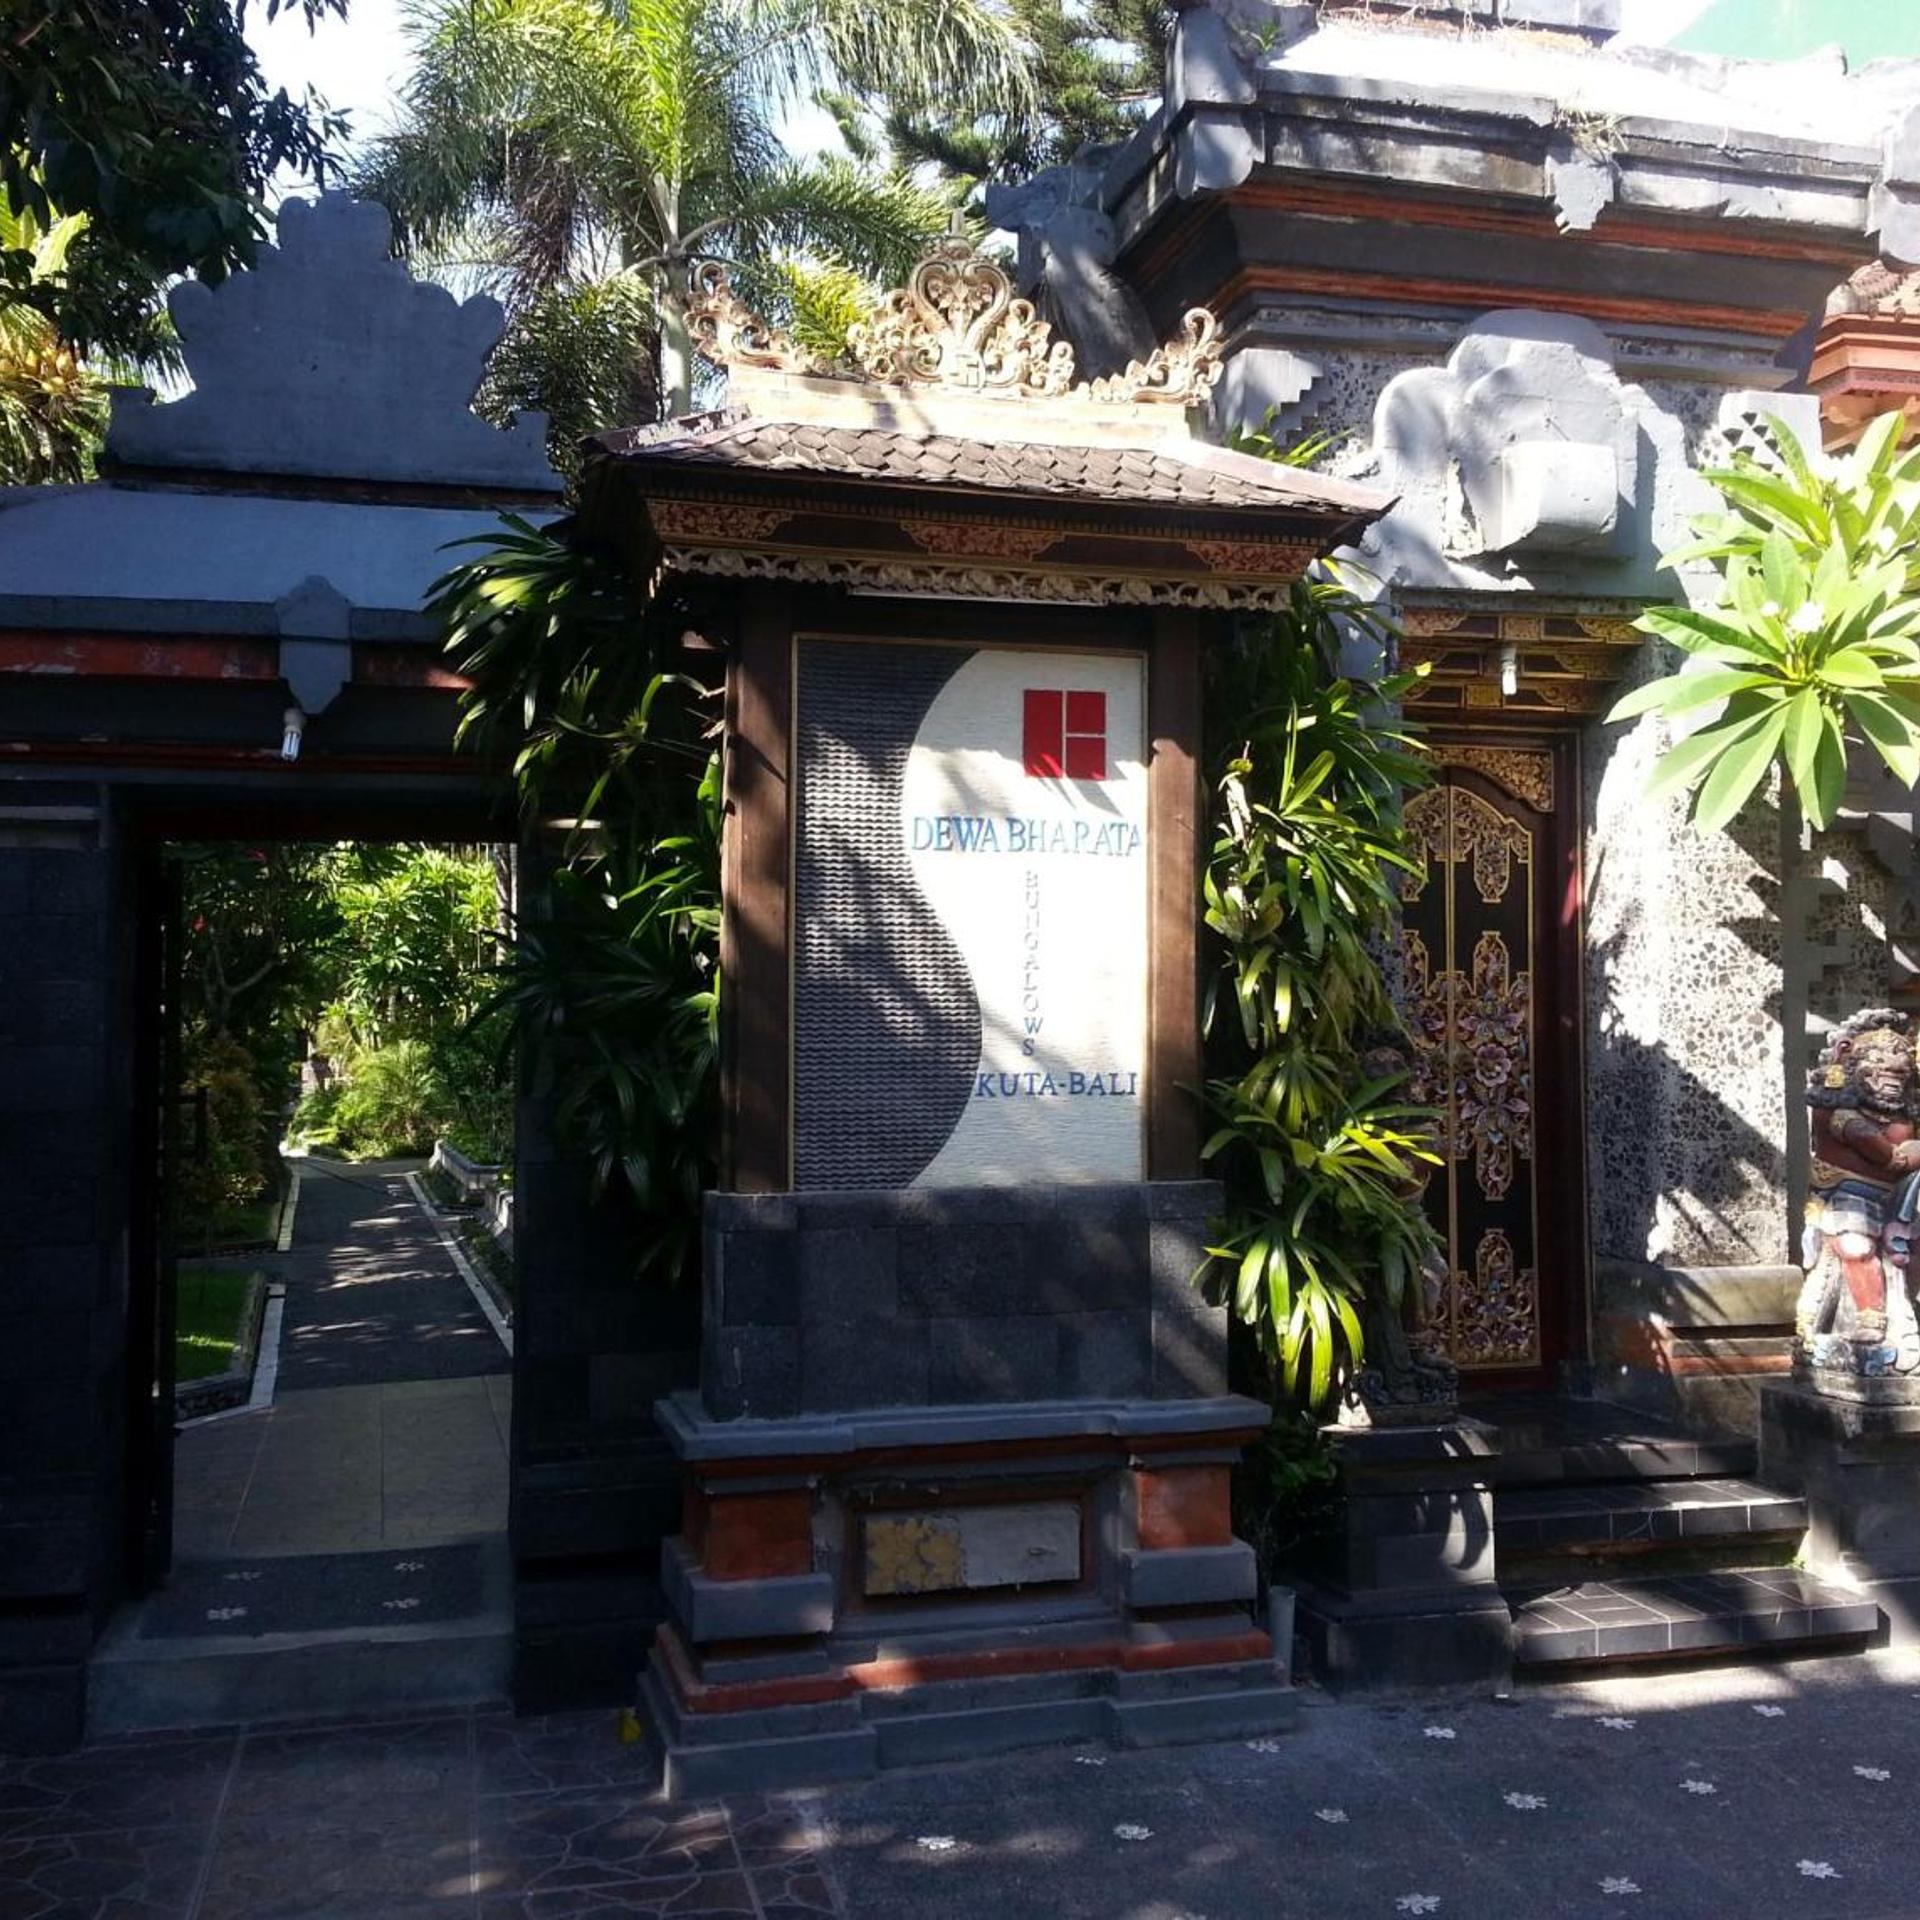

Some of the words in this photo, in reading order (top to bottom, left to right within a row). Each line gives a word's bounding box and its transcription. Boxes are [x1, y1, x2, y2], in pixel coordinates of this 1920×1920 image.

[911, 816, 1002, 853] DEWA
[1005, 817, 1142, 856] BHARATA
[975, 1072, 1137, 1098] KUTA-BALI
